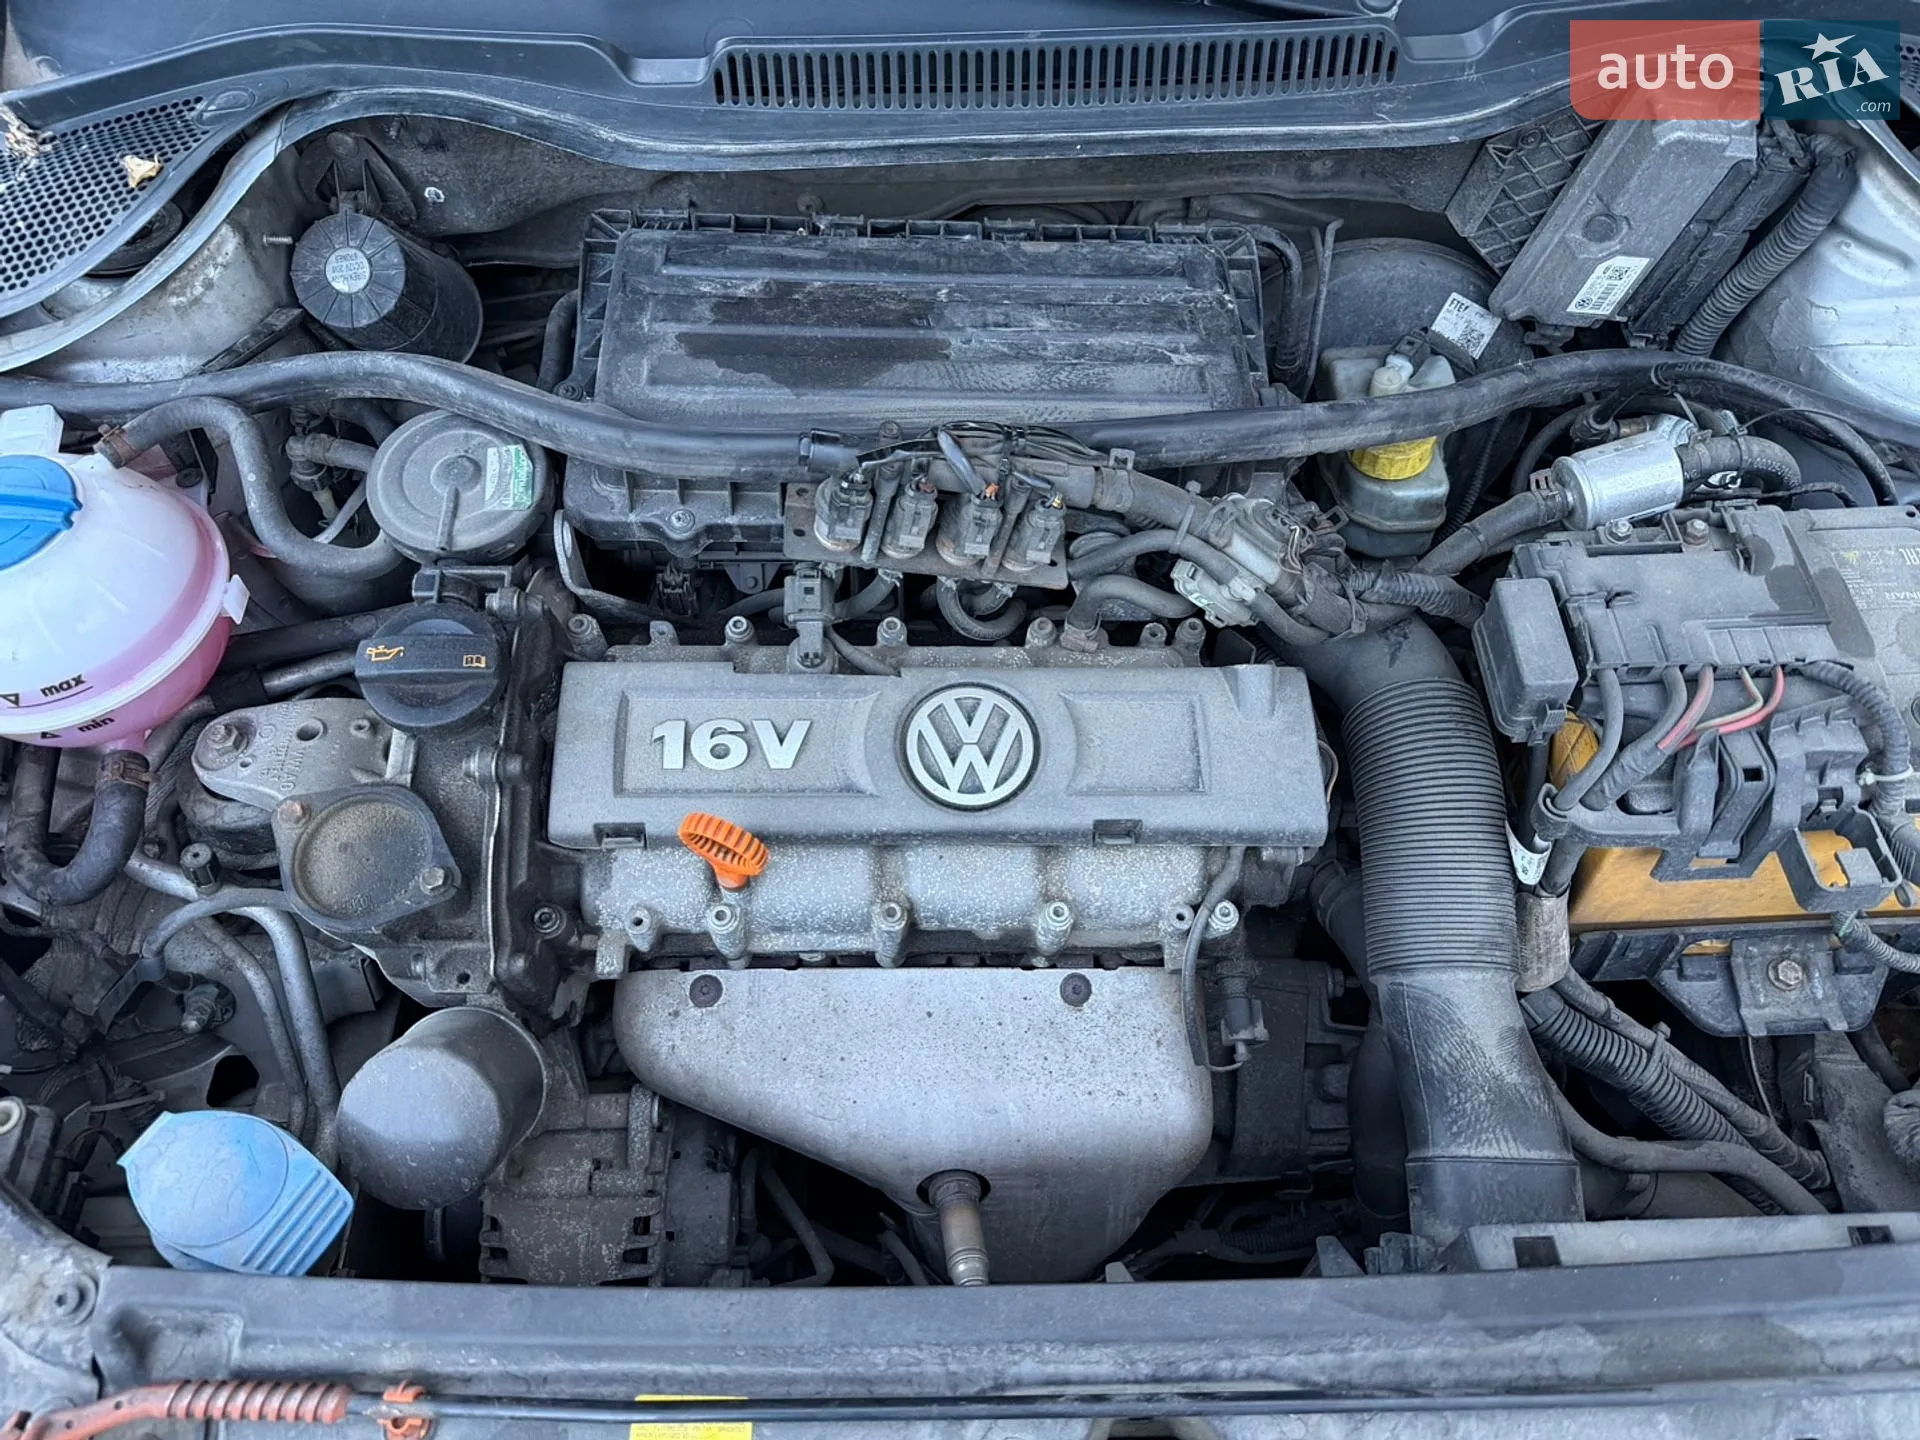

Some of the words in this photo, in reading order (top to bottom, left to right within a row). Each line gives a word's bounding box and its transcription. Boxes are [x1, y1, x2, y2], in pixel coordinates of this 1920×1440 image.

[40, 674, 86, 698] max
[77, 717, 116, 733] min
[651, 718, 813, 771] 16V
